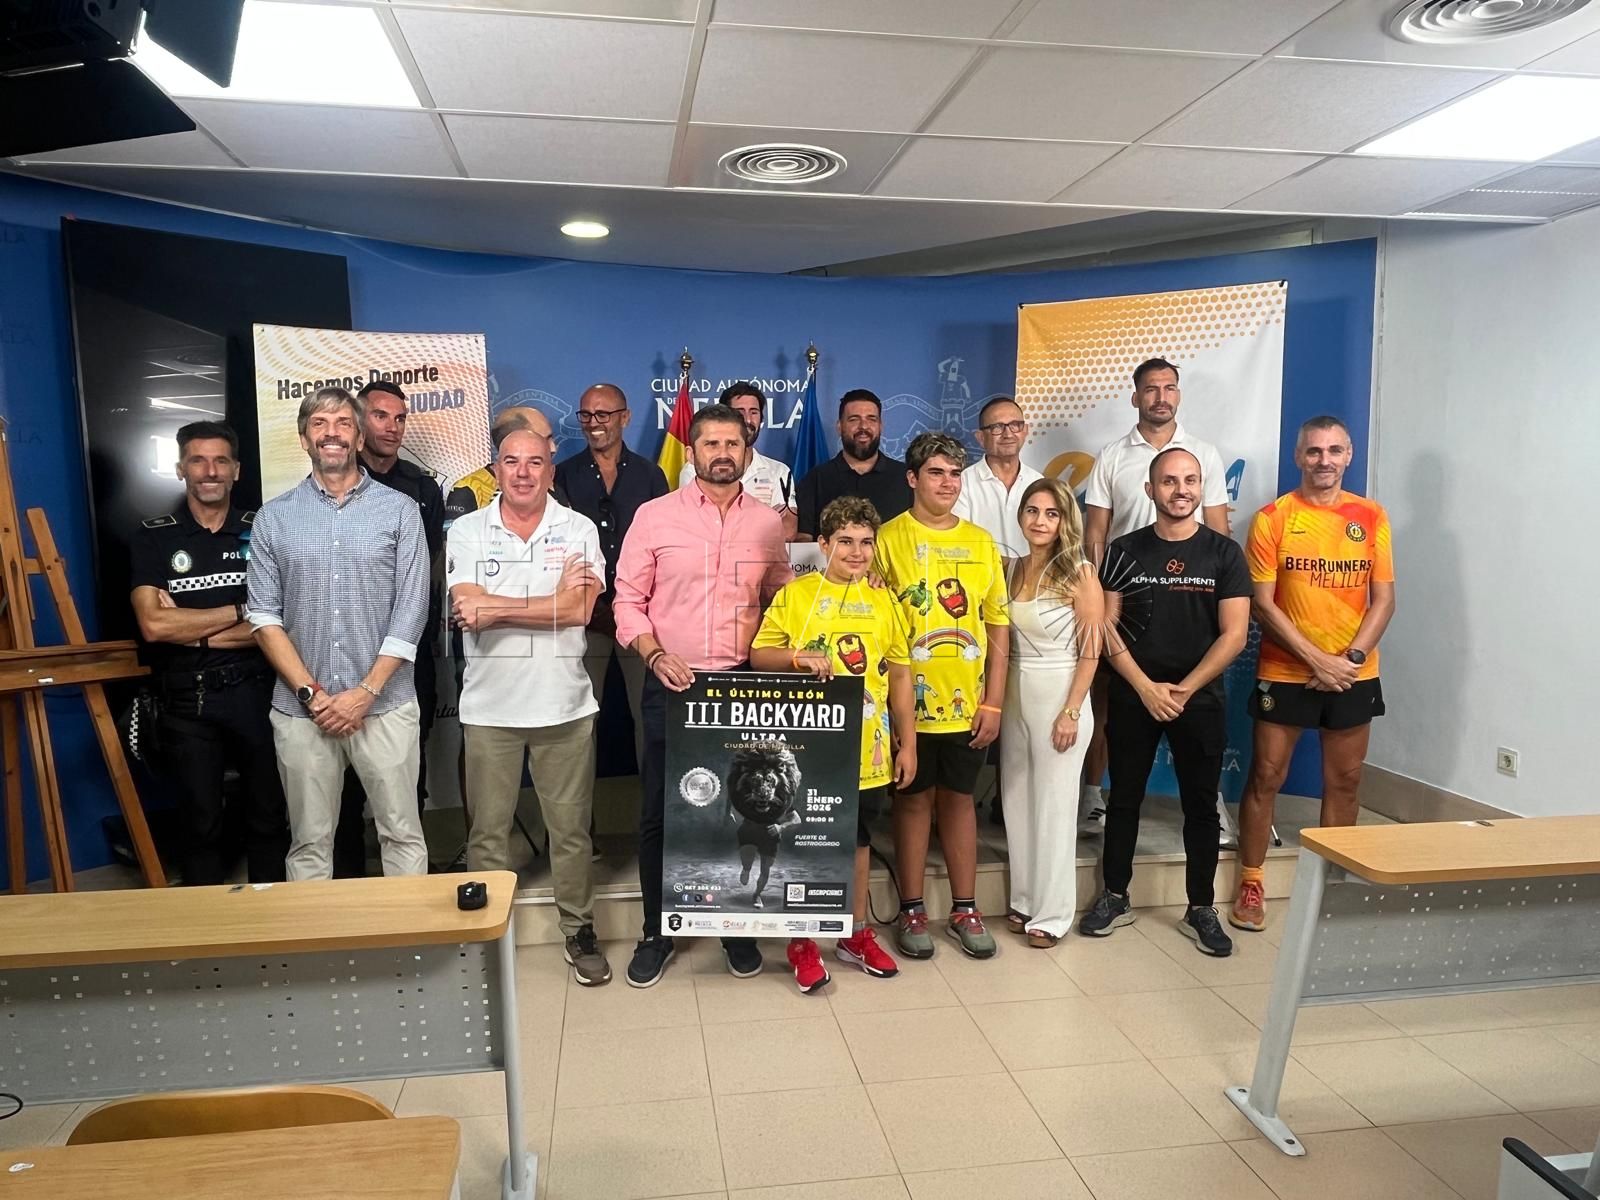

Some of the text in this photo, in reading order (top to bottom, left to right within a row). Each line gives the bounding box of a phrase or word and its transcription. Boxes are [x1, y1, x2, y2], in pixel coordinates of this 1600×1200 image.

[651, 376, 808, 393] CIUAD AUÓNOMA
[1160, 577, 1216, 586] SUPPLEMENTS
[707, 687, 824, 700] EL ÚLTIMO LEÓN
[685, 702, 846, 728] III BACKYARD
[741, 732, 787, 741] ULTRA
[807, 788, 817, 796] 31
[806, 796, 843, 804] ENERO
